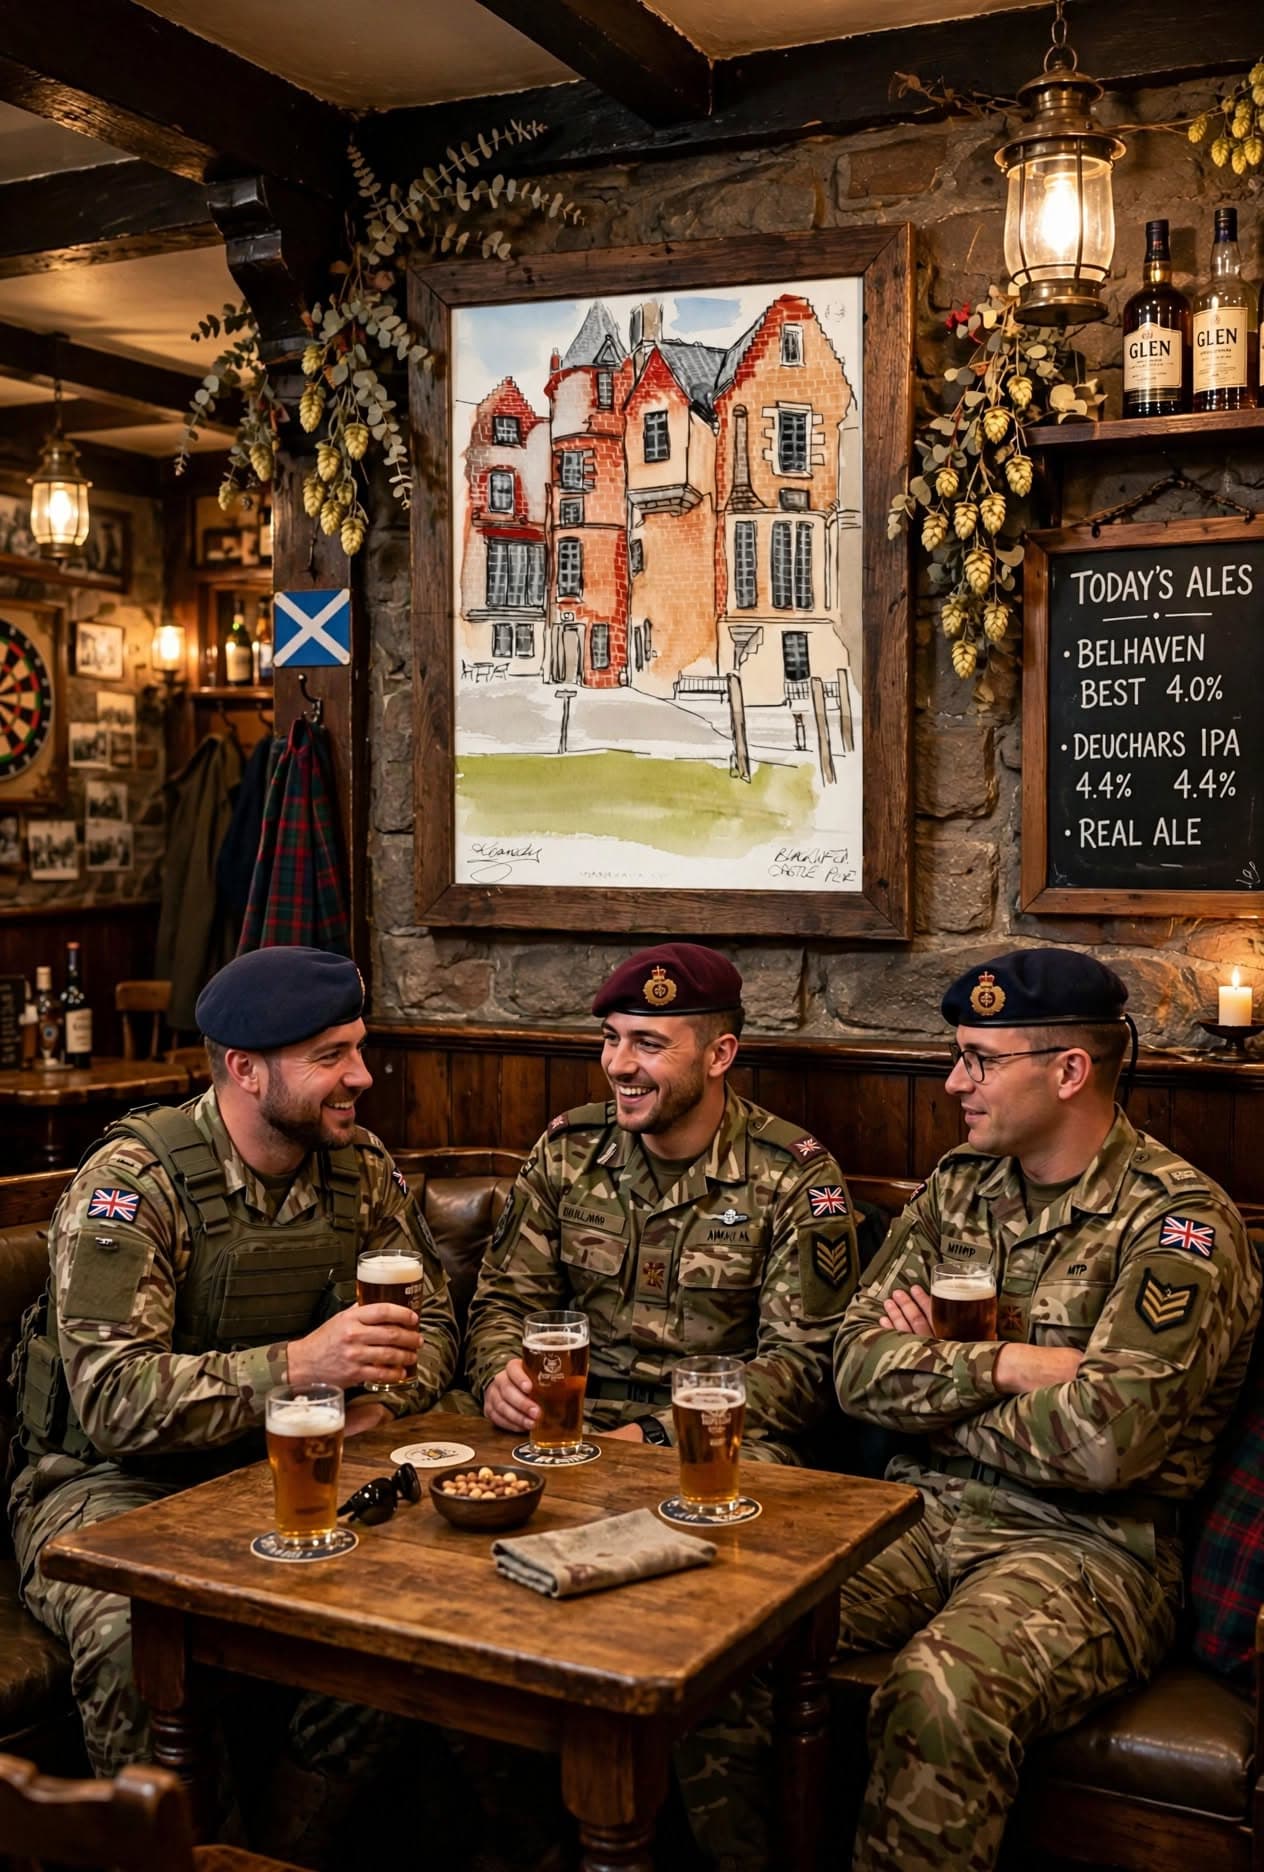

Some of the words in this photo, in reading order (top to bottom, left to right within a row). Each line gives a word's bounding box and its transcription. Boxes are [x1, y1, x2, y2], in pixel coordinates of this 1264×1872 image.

[1129, 340, 1171, 359] GLEN
[1197, 327, 1238, 348] GLEN
[1070, 565, 1174, 605] TODAY'S
[1185, 564, 1253, 598] ALES
[1077, 633, 1205, 669] BELHAVEN
[1080, 677, 1146, 709] BEST
[1166, 674, 1223, 703] 4.0%
[1073, 730, 1186, 761] DEUCHARS
[1201, 728, 1241, 757] IPA
[1075, 771, 1132, 800] 4.4%
[1173, 768, 1236, 799] 4.4%
[1078, 817, 1143, 849] REAL
[1152, 817, 1202, 846] ALE
